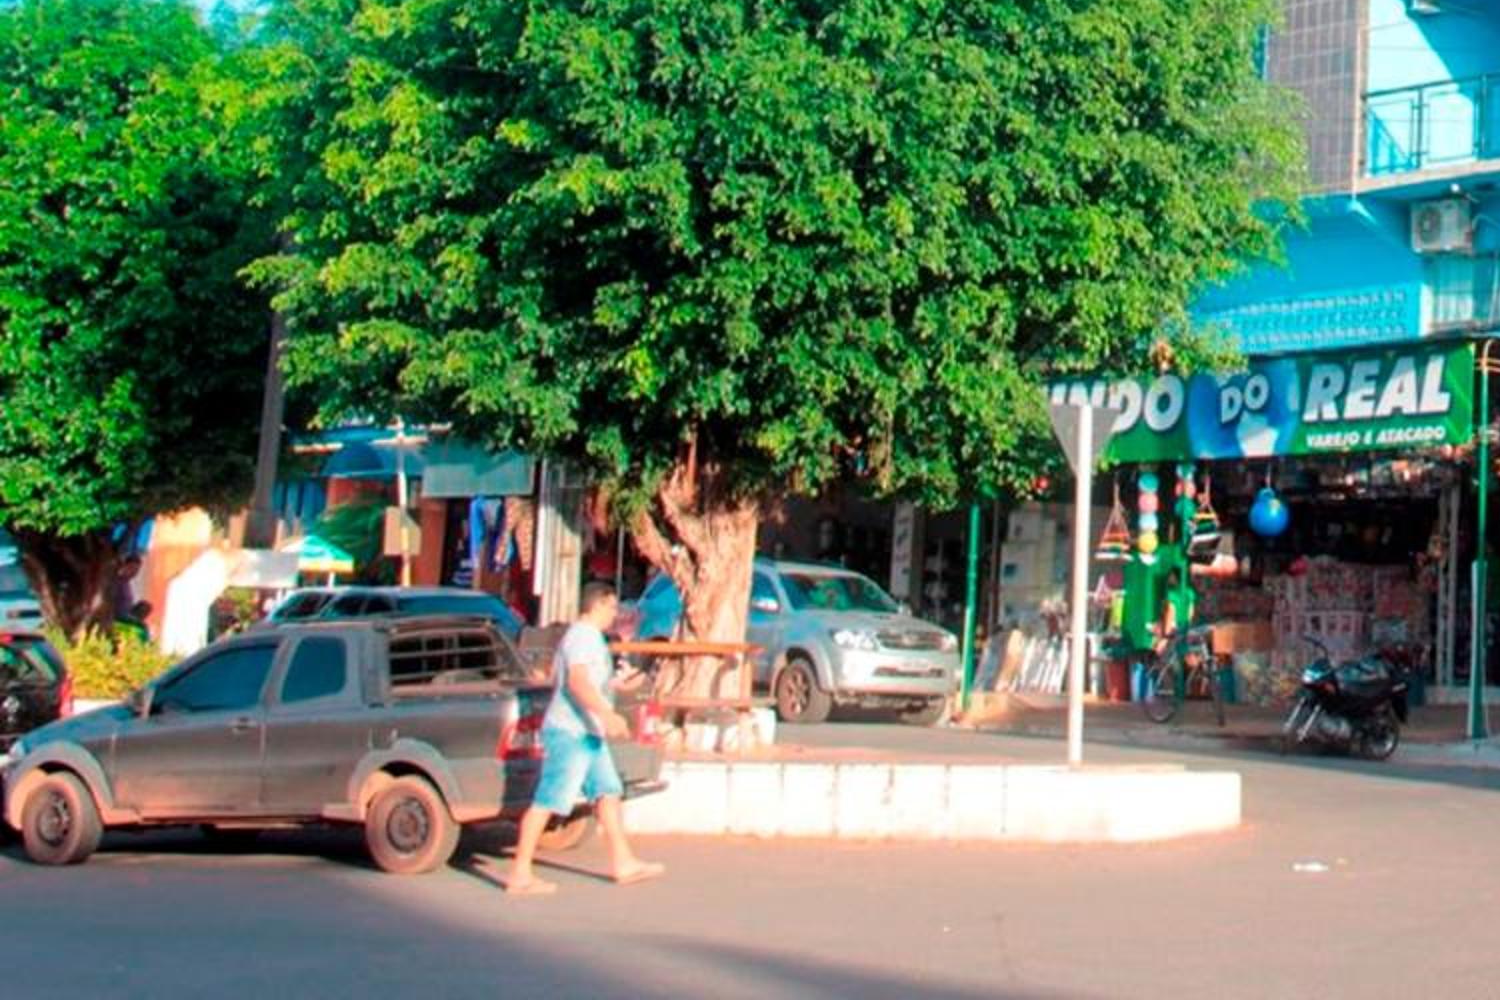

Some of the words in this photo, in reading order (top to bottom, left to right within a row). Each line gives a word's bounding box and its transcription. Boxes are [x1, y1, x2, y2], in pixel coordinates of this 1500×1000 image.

[1220, 373, 1269, 425] DO
[1303, 353, 1451, 423] REAL
[1306, 430, 1360, 448] VAREJO
[1363, 429, 1373, 445] E
[1376, 426, 1446, 445] ATACADO
